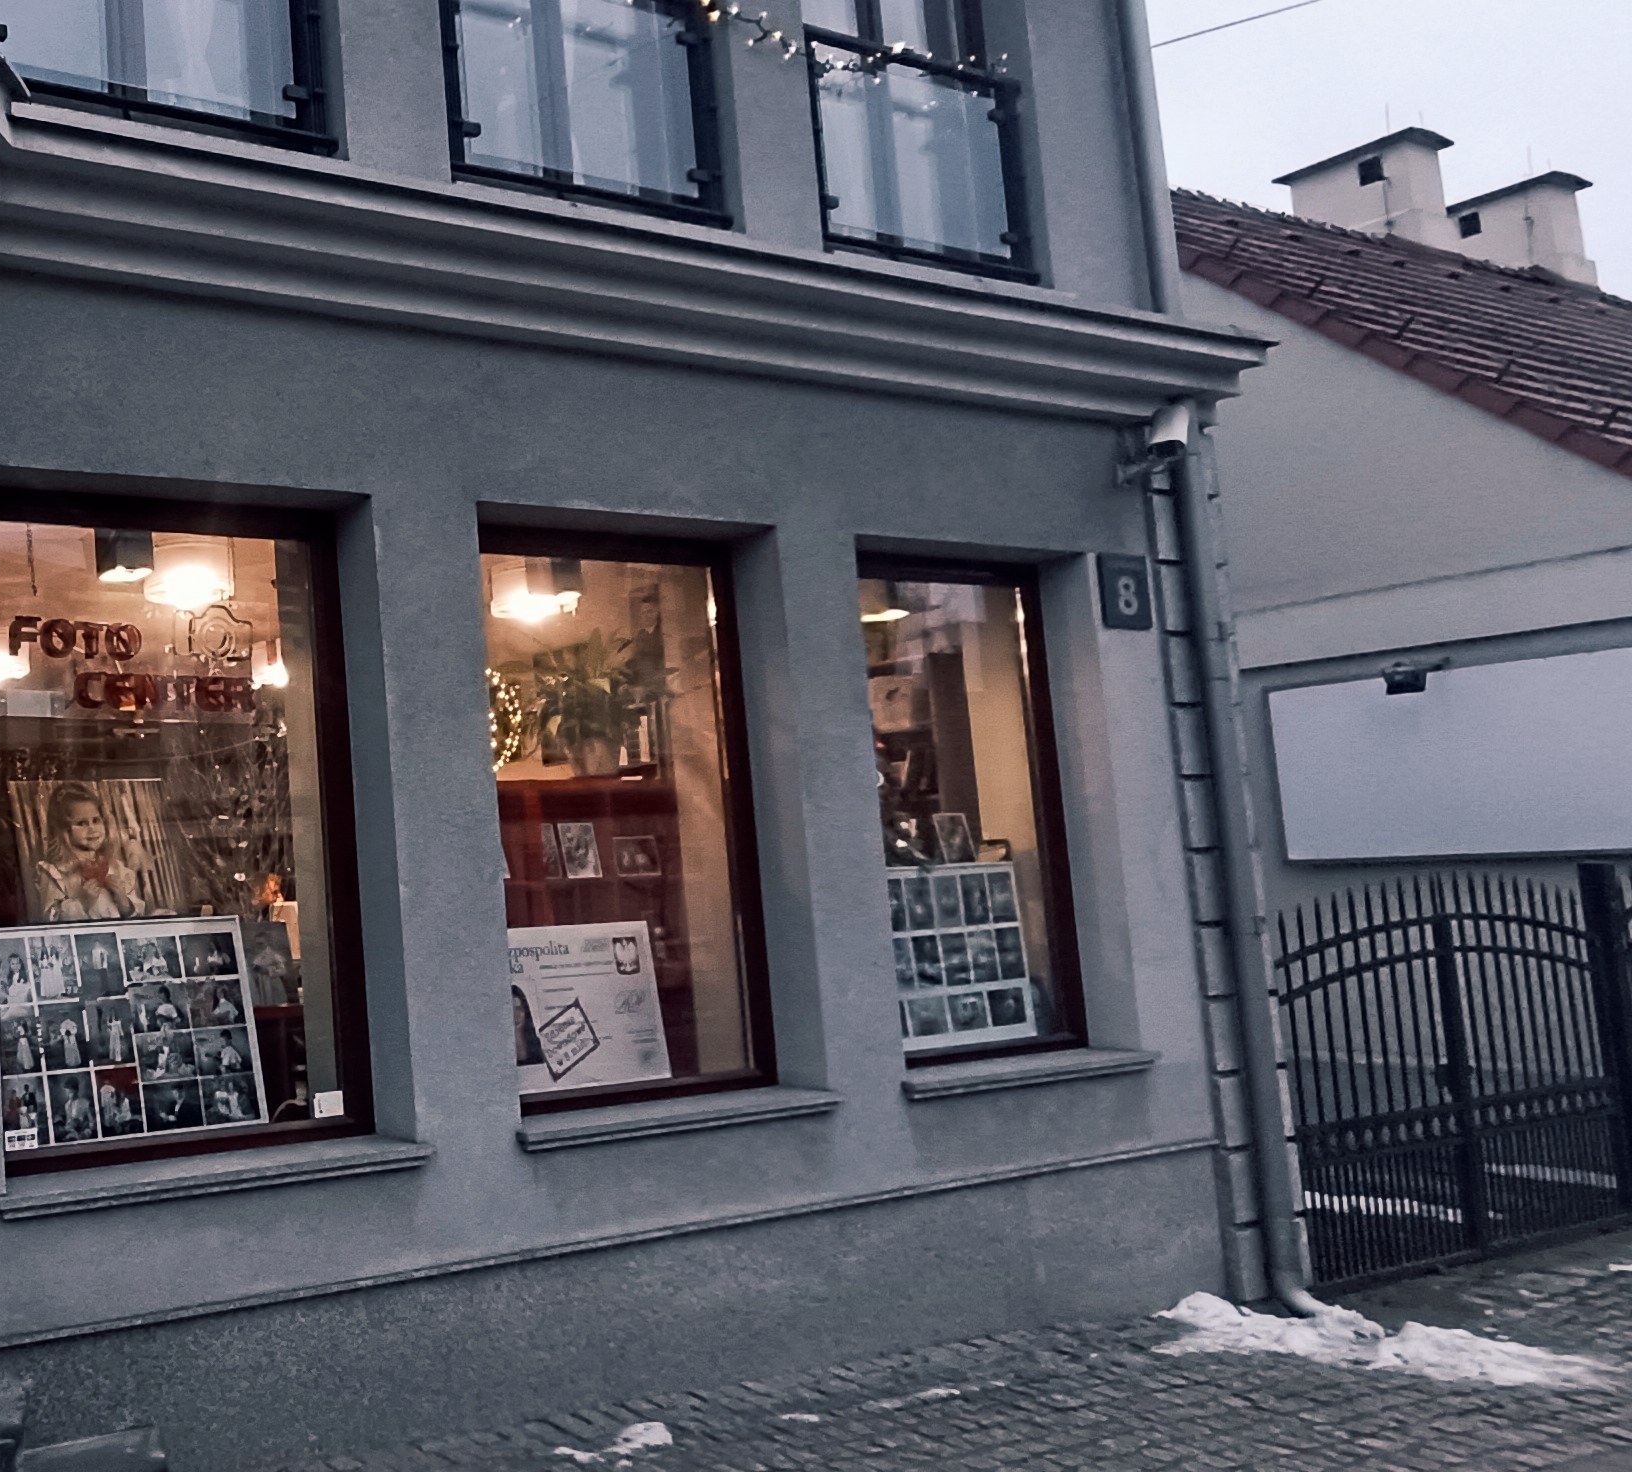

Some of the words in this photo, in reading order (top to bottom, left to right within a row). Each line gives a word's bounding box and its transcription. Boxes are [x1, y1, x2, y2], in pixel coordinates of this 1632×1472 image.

[1117, 575, 1139, 616] 8
[8, 615, 142, 661] FOTO
[73, 671, 257, 713] CENTER
